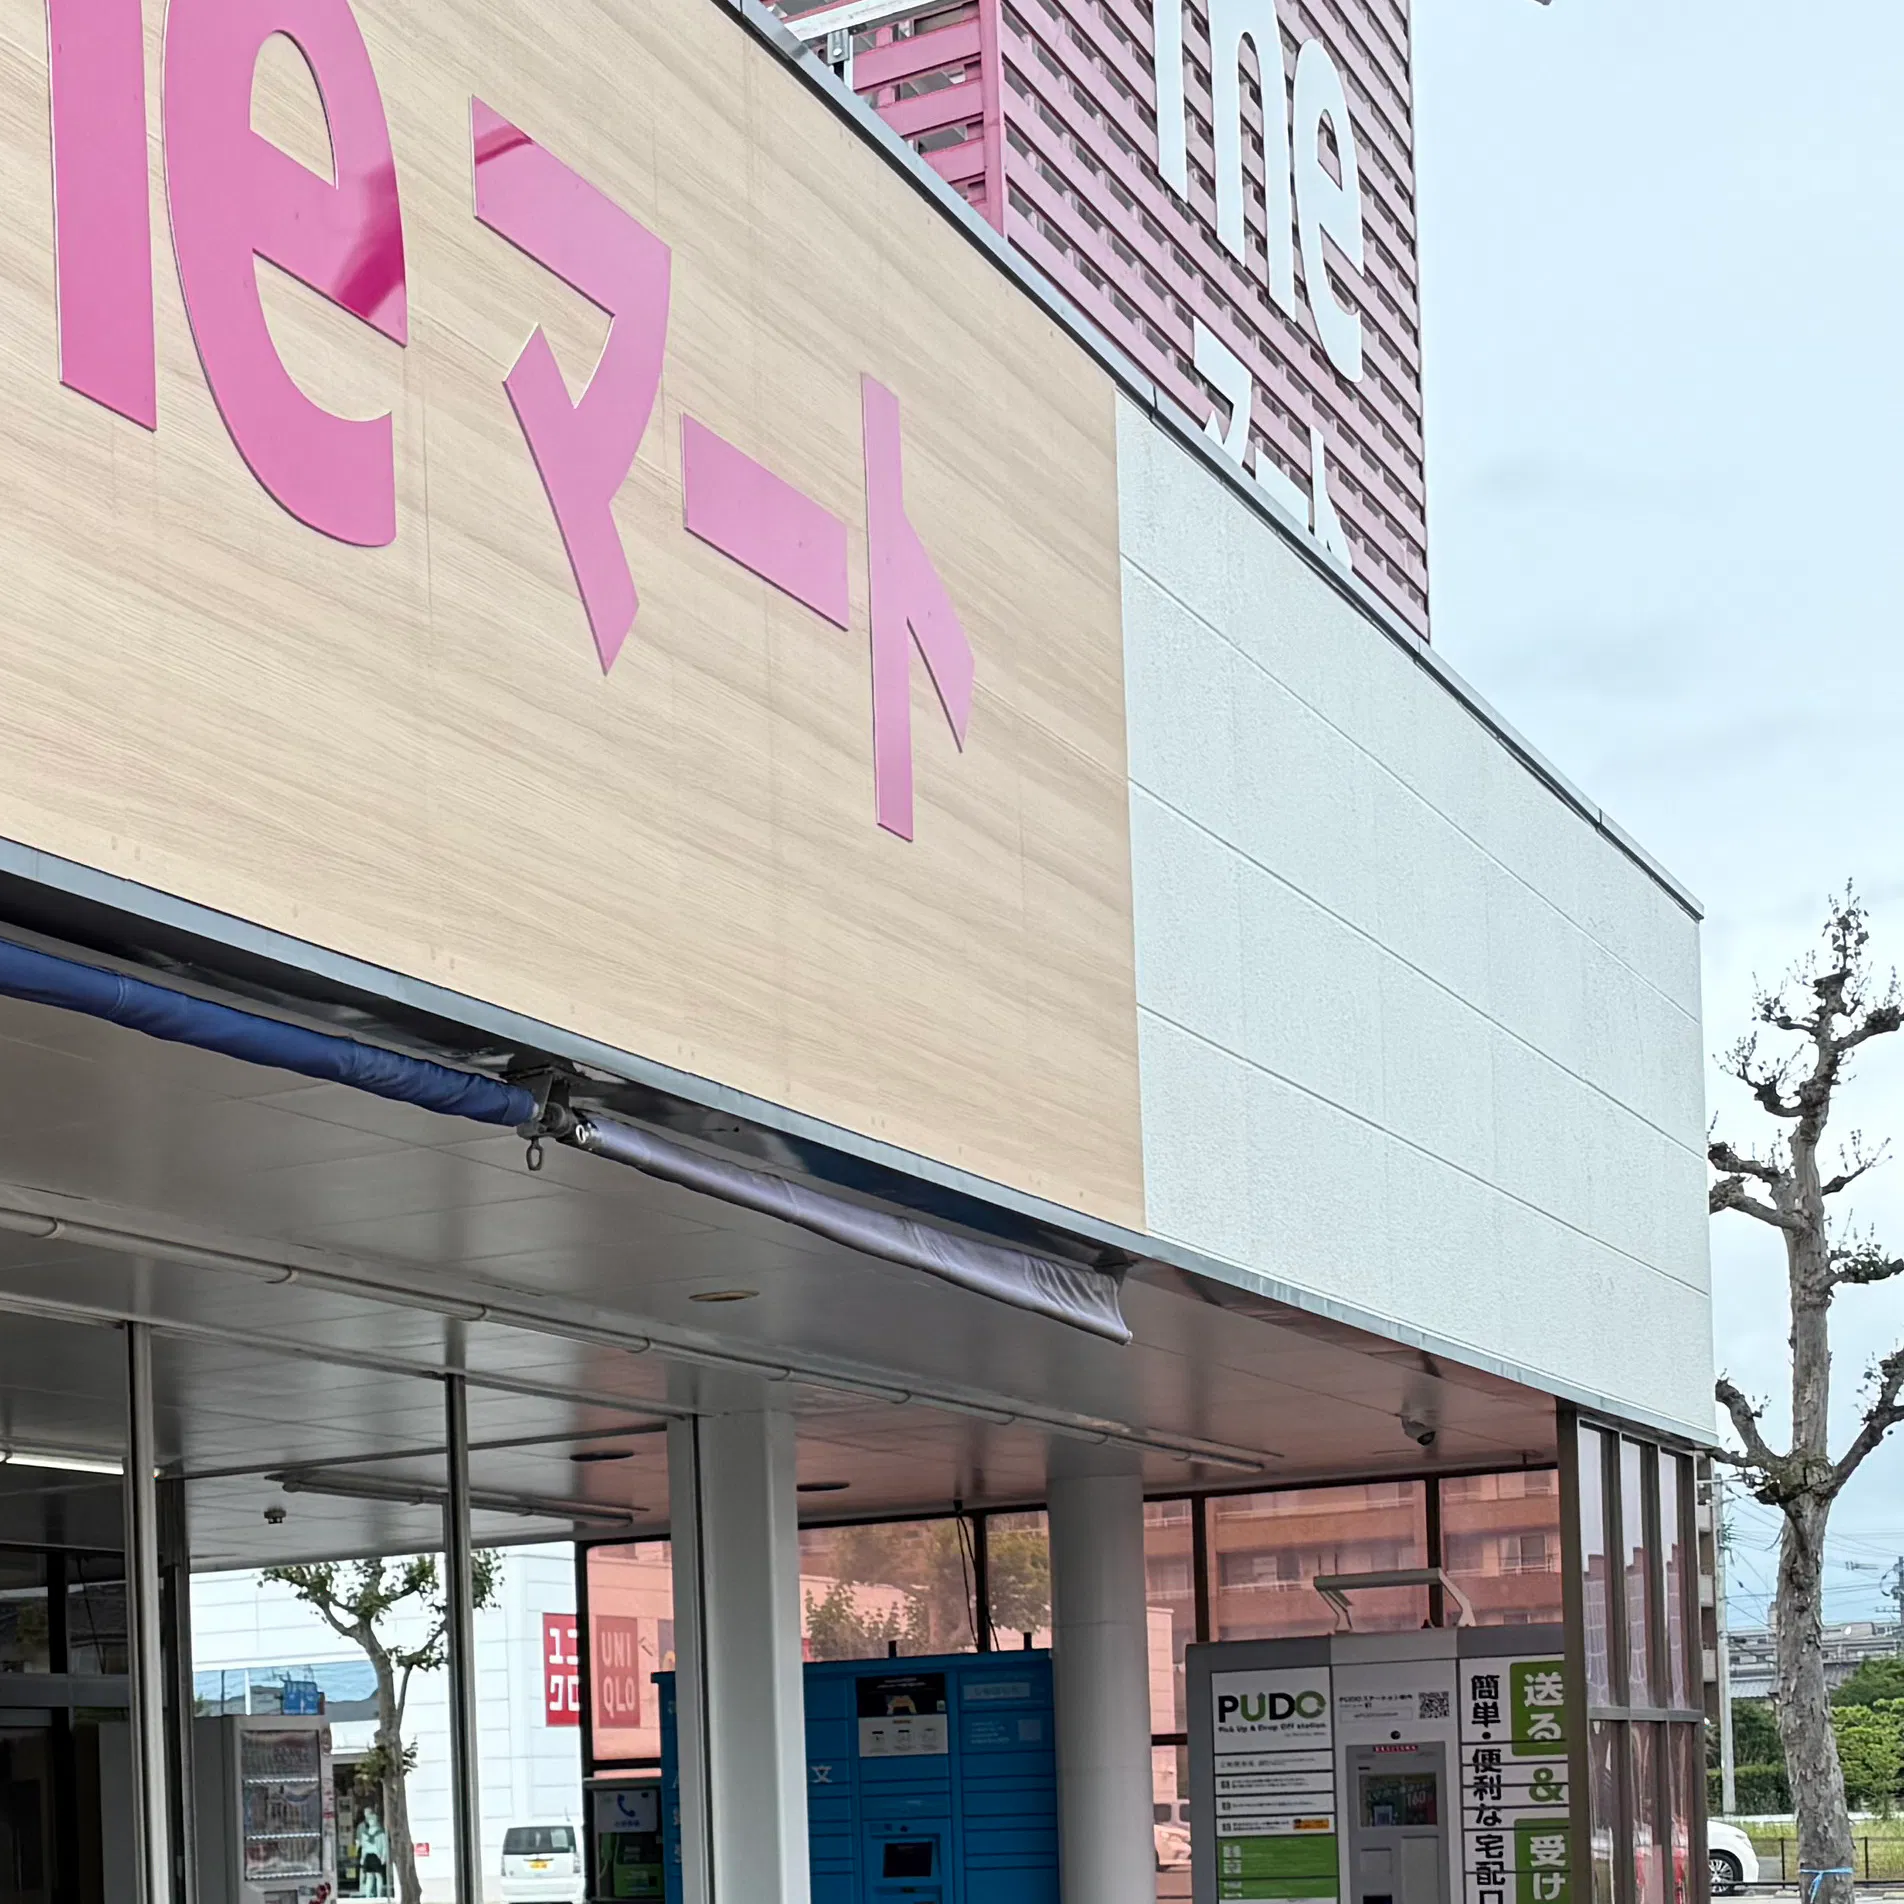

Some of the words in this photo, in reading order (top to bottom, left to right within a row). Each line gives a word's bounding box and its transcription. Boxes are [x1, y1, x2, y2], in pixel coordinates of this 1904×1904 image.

[601, 1631, 632, 1668] UNI
[603, 1676, 636, 1719] QLO
[1218, 1690, 1326, 1723] PUDO
[1524, 1671, 1565, 1741] 送る
[1237, 1725, 1247, 1734] Up
[1258, 1724, 1277, 1733] Drop
[1529, 1768, 1565, 1803] &
